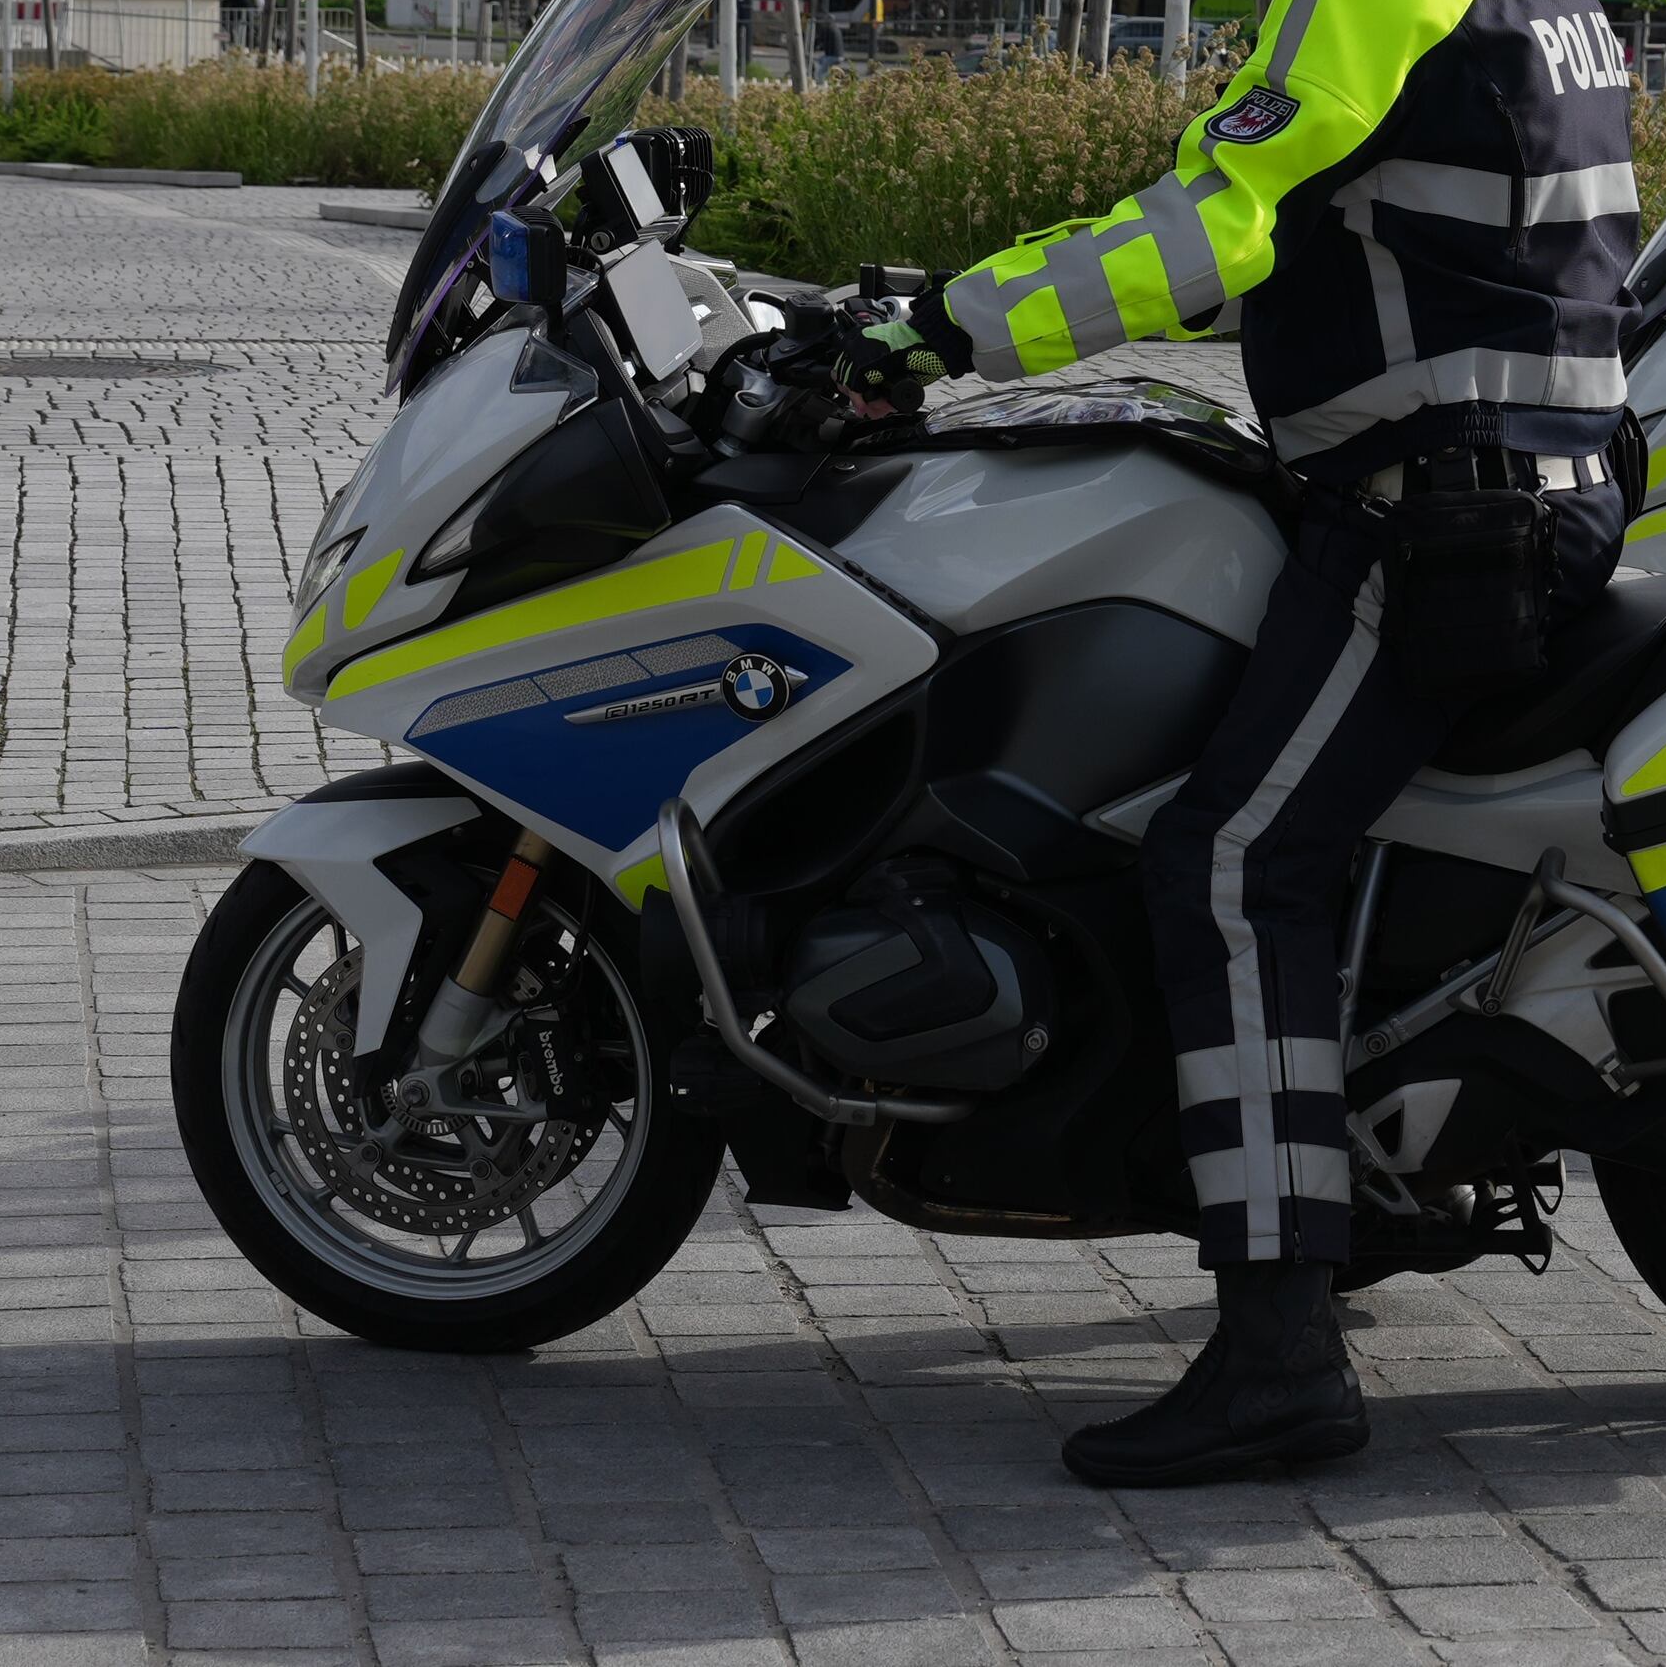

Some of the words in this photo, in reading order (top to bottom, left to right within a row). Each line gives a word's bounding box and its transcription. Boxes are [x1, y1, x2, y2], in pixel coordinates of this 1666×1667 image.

[1529, 12, 1630, 95] POLIZE
[1252, 92, 1292, 116] POLIZEI
[725, 658, 776, 683] BMW
[538, 1030, 564, 1096] brembo
